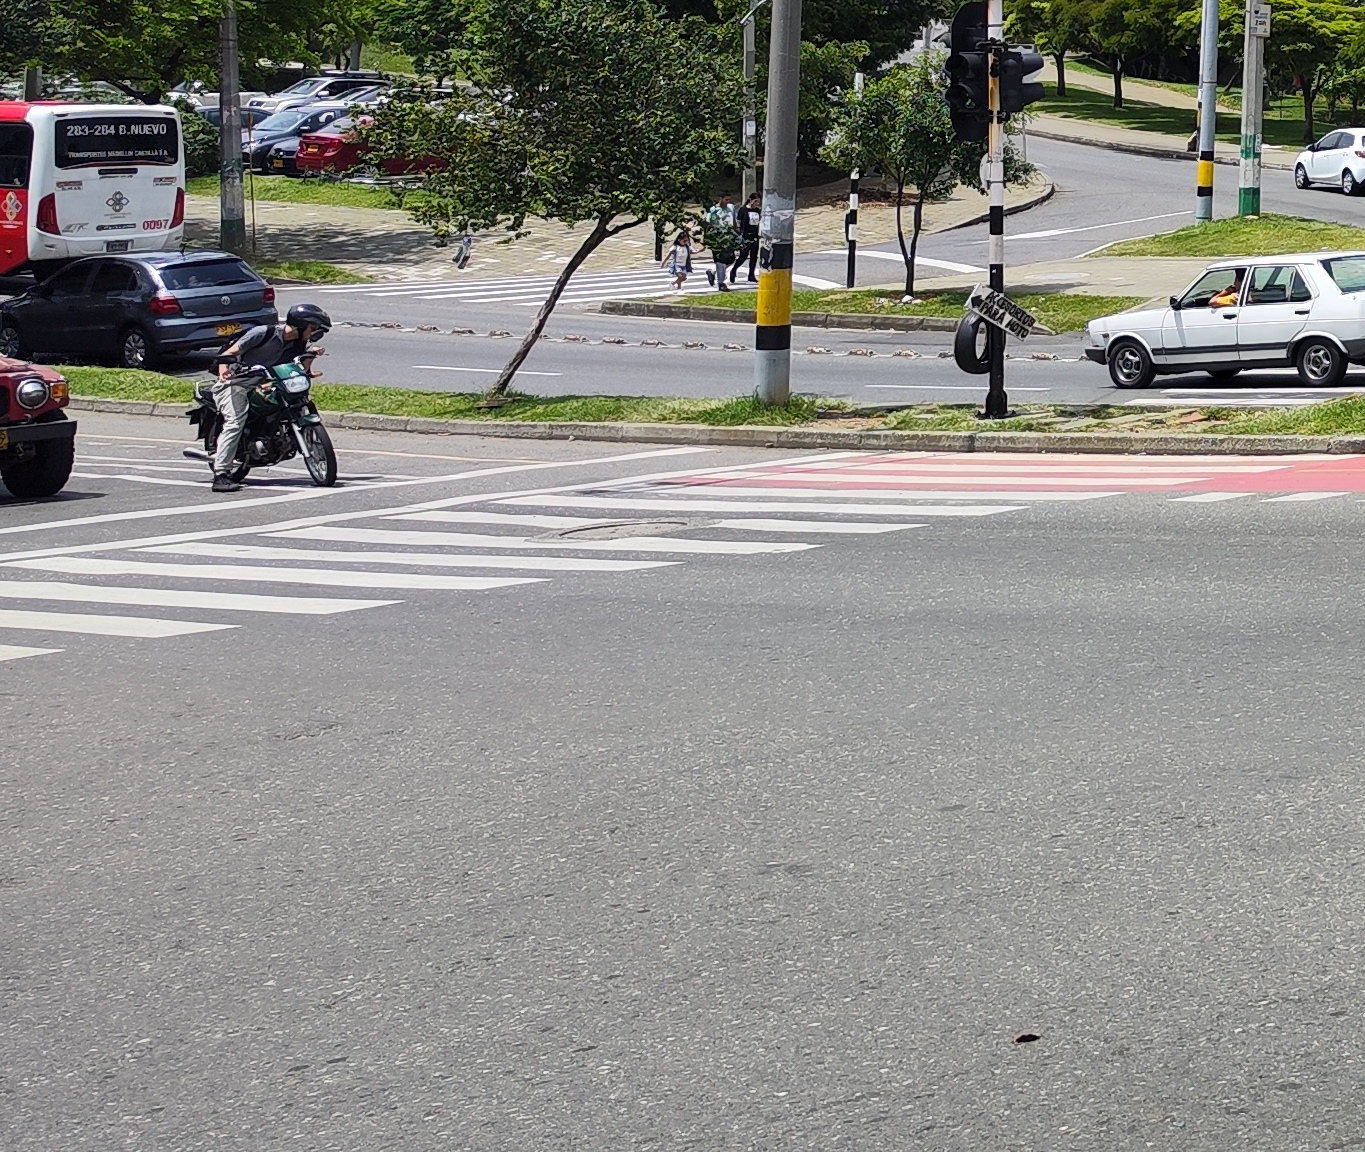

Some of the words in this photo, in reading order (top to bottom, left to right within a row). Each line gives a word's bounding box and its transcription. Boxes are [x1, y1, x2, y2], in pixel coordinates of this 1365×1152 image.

[142, 219, 169, 231] 0097
[979, 301, 1006, 325] PARA
[1005, 318, 1030, 338] MOTO
